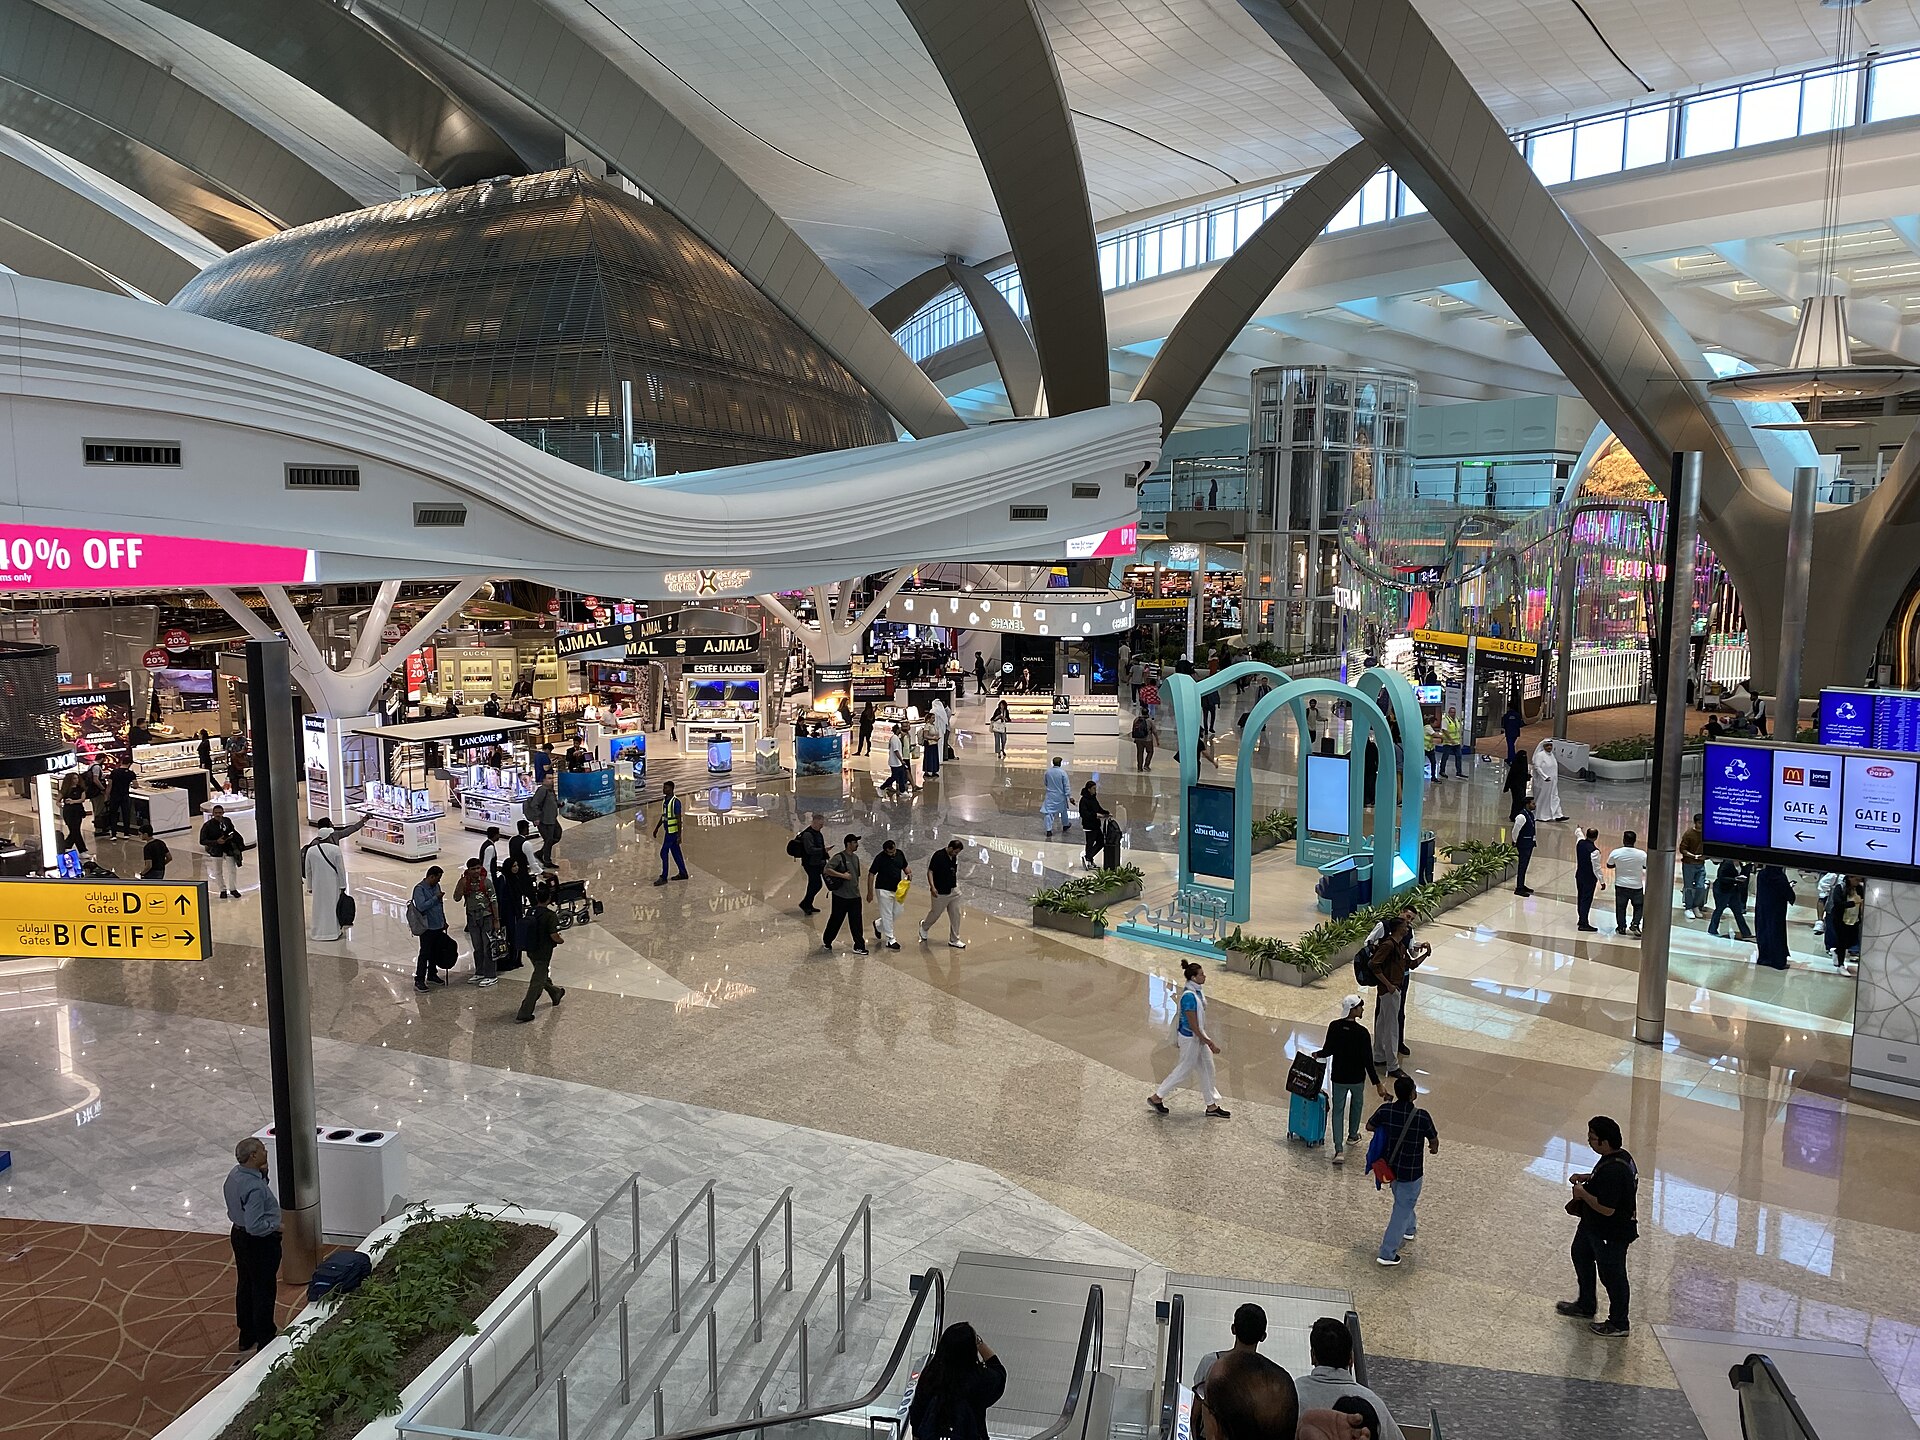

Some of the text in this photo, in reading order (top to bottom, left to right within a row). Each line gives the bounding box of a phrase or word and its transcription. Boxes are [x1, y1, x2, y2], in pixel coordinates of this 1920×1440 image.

[83, 538, 142, 569] OFF
[14, 572, 32, 583] only
[641, 620, 662, 637] AJMAL
[990, 618, 1026, 632] CHANEL
[558, 632, 608, 654] AJMAL
[1426, 632, 1430, 640] D
[704, 638, 752, 653] AJMAL
[1500, 642, 1504, 650] B
[1506, 642, 1511, 650] C
[1513, 644, 1517, 652] E
[1519, 644, 1523, 652] F
[460, 734, 496, 746] LANCÔME
[46, 752, 76, 772] DIOR
[1784, 800, 1828, 816] GATE A
[1855, 808, 1901, 823] GATE D
[1194, 828, 1230, 838] abu dhabi
[84, 892, 119, 903] البوابات
[88, 892, 142, 914] Gates D
[16, 924, 50, 934] البوابات
[20, 924, 144, 947] Gates B C E F
